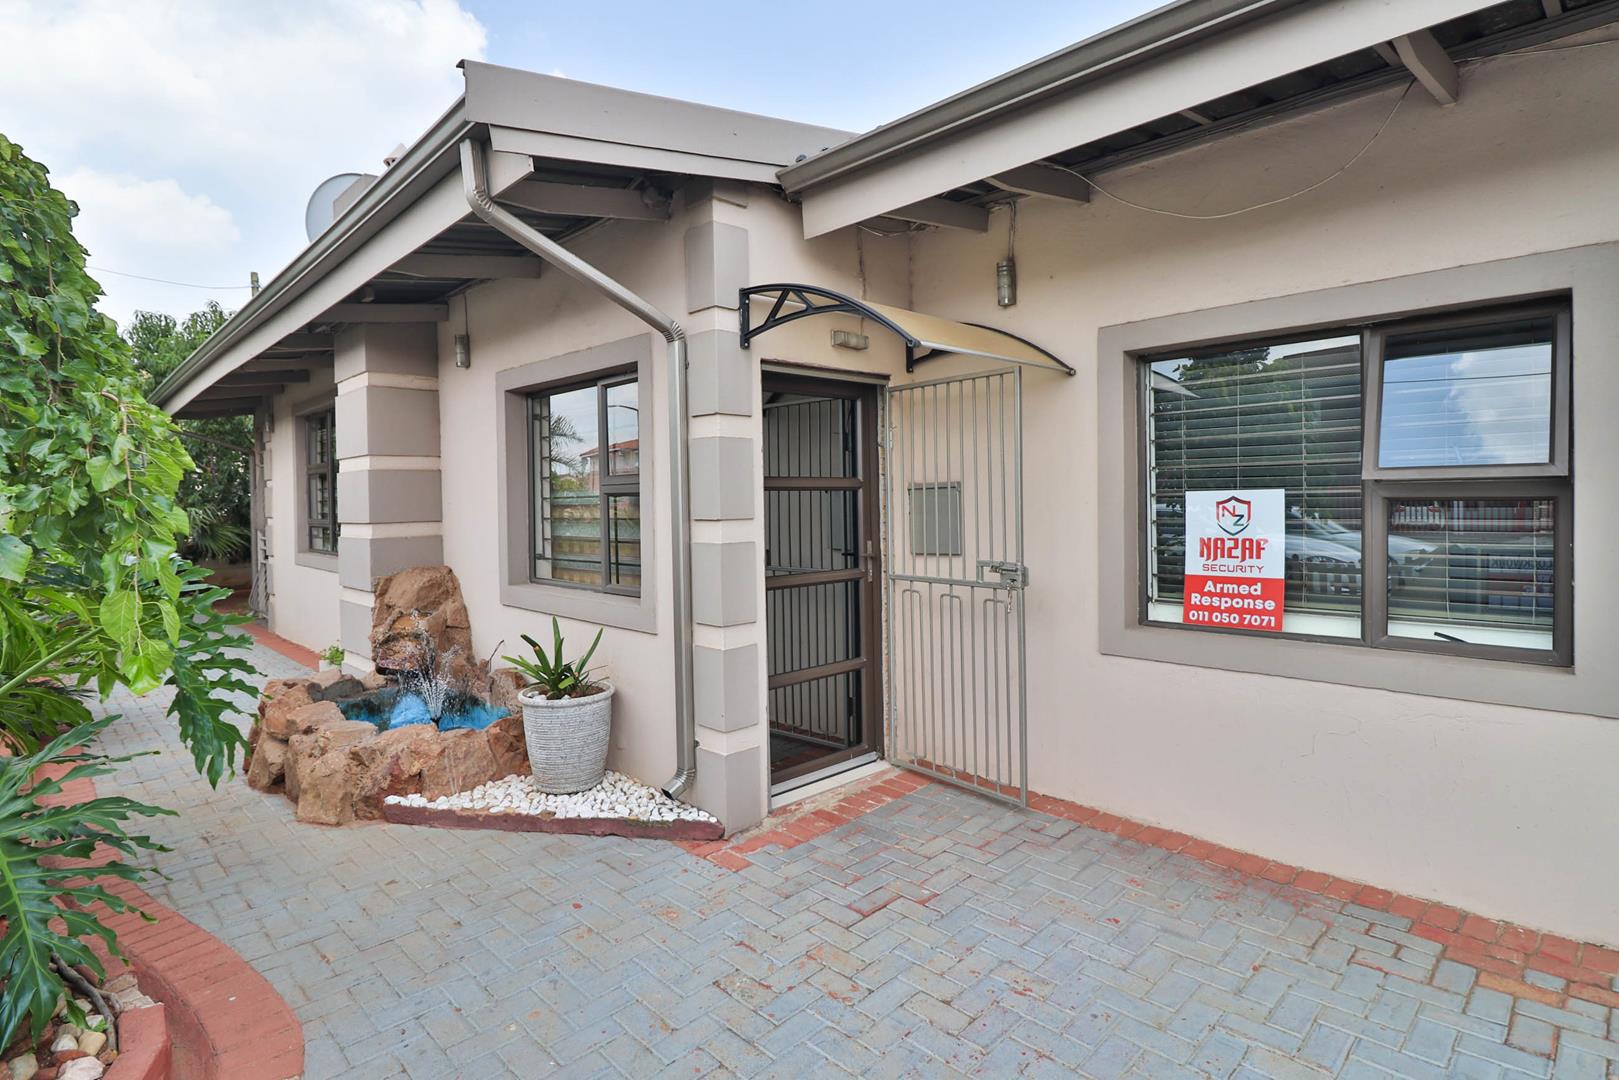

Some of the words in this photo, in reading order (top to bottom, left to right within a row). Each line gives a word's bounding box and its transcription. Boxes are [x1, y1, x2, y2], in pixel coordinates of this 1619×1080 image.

[1199, 537, 1269, 563] NAZAF
[1202, 564, 1264, 573] SECURITY
[1204, 581, 1262, 595] Armed
[1191, 594, 1276, 610] Response
[1189, 611, 1209, 622] 011
[1212, 612, 1240, 624] 050
[1243, 615, 1276, 627] 7071
